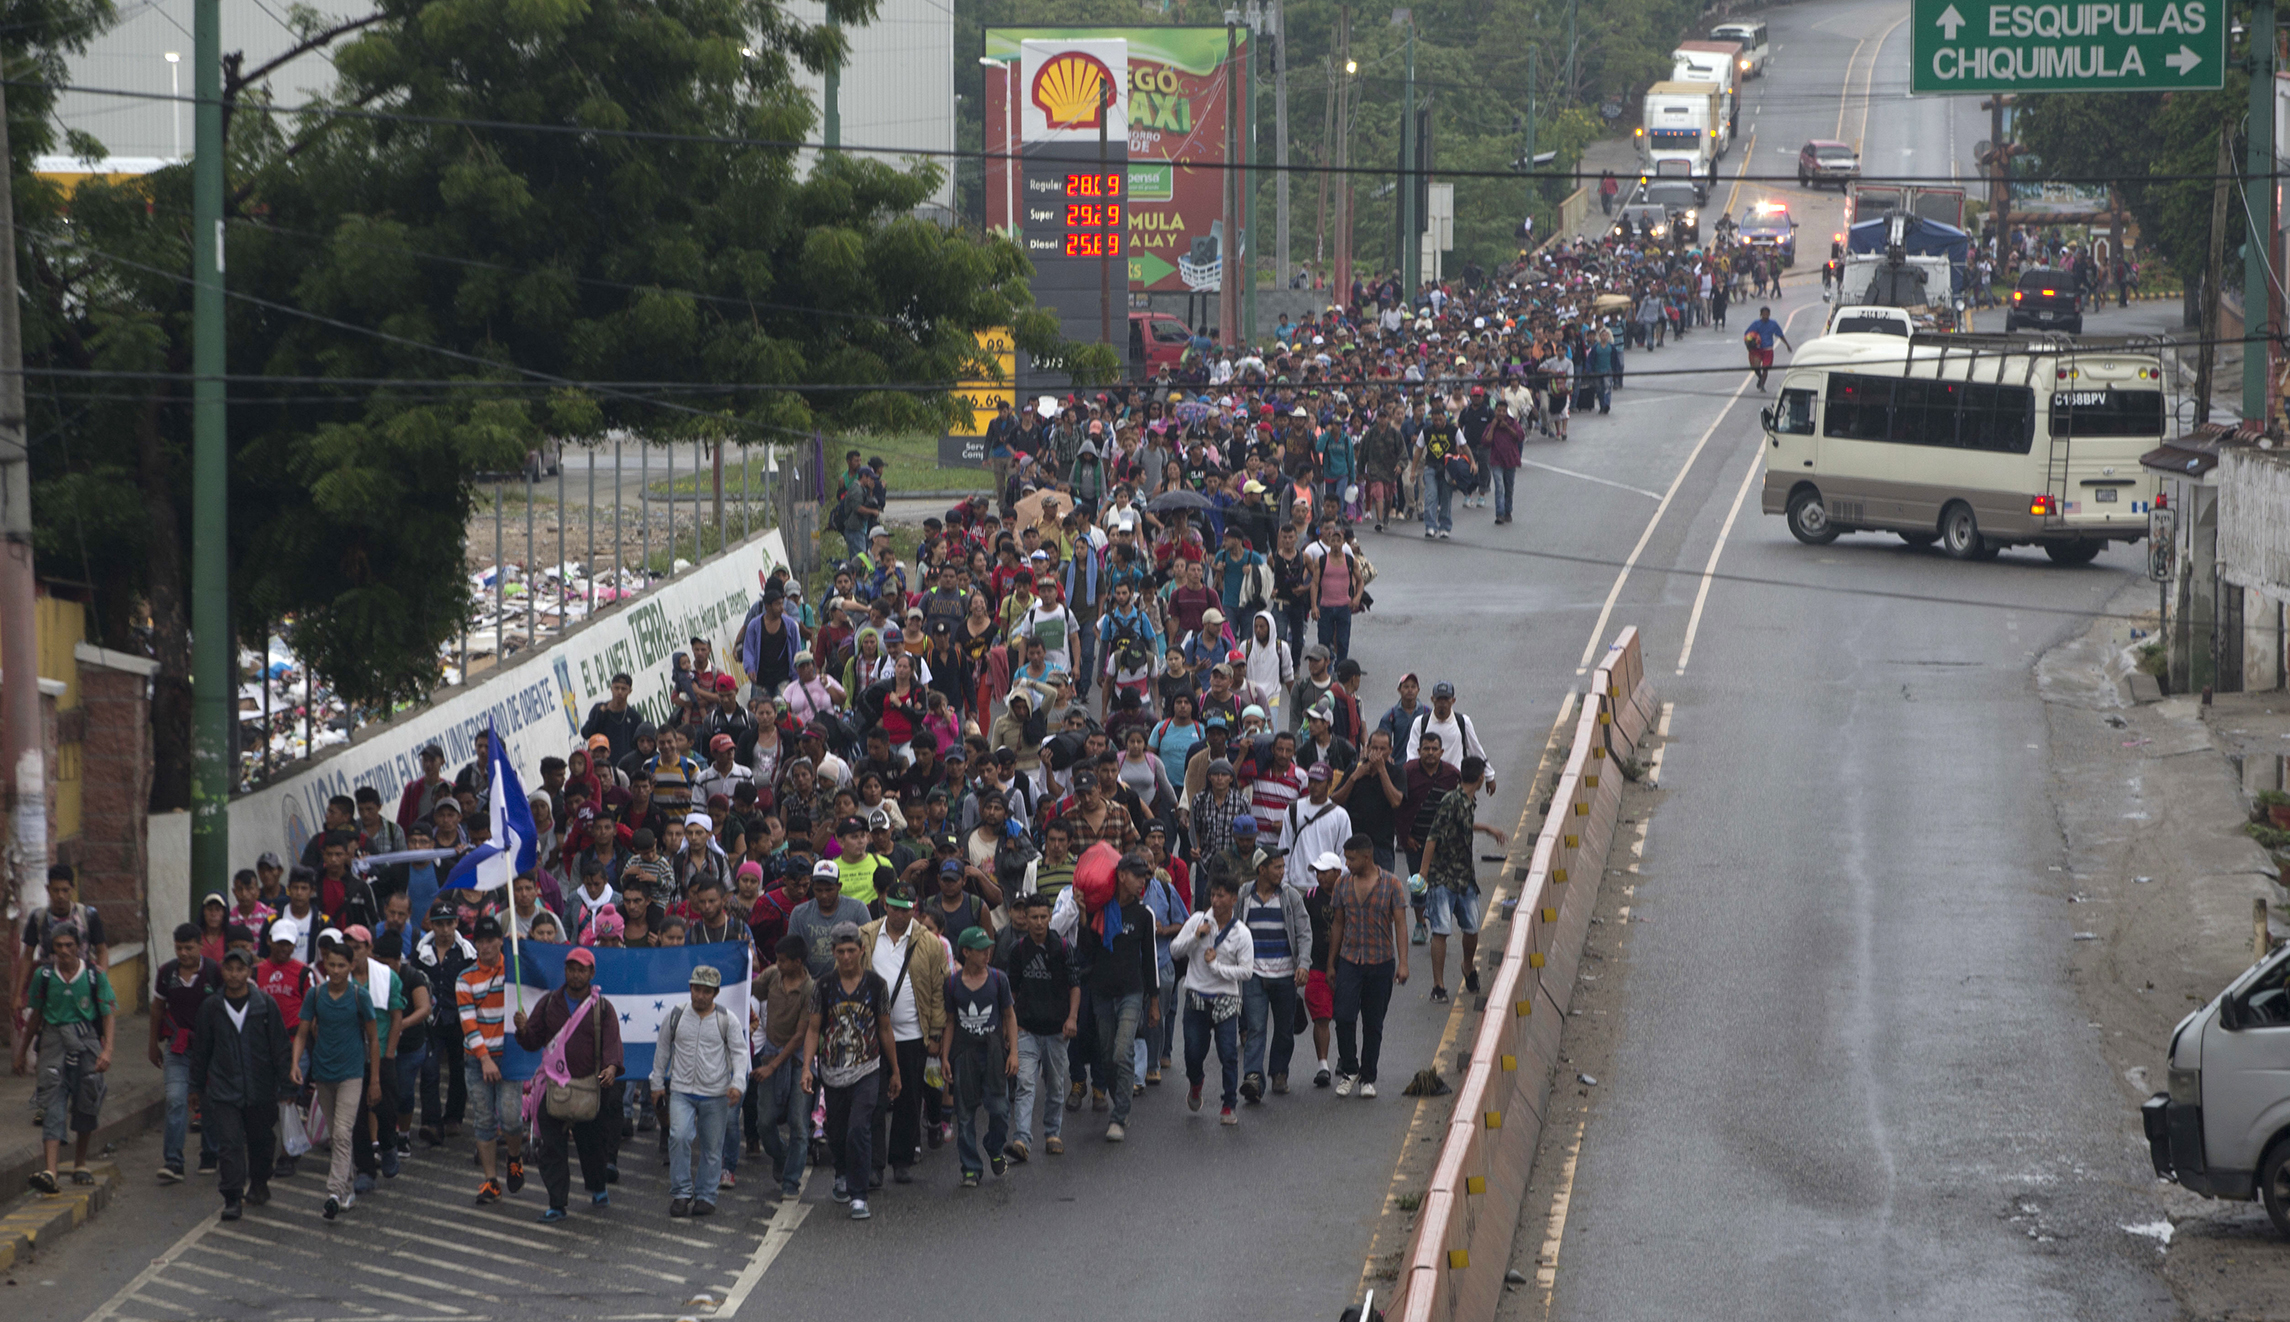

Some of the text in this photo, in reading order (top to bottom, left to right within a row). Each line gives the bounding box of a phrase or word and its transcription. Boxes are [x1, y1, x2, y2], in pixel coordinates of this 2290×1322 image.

[1989, 2, 2206, 39] ESQUIPULAS
[1933, 45, 2146, 81] CHIQUIMULA
[1030, 178, 1062, 193] Regular
[1030, 208, 1054, 222] Super
[1030, 239, 1058, 249] Diesel
[580, 659, 597, 698] EL
[594, 638, 636, 693] PLANETA
[627, 598, 675, 672] TIERRA
[411, 733, 450, 781] CERO
[505, 693, 523, 733] DE
[519, 677, 556, 723] ORIENTE
[1022, 969, 1052, 979] adidas
